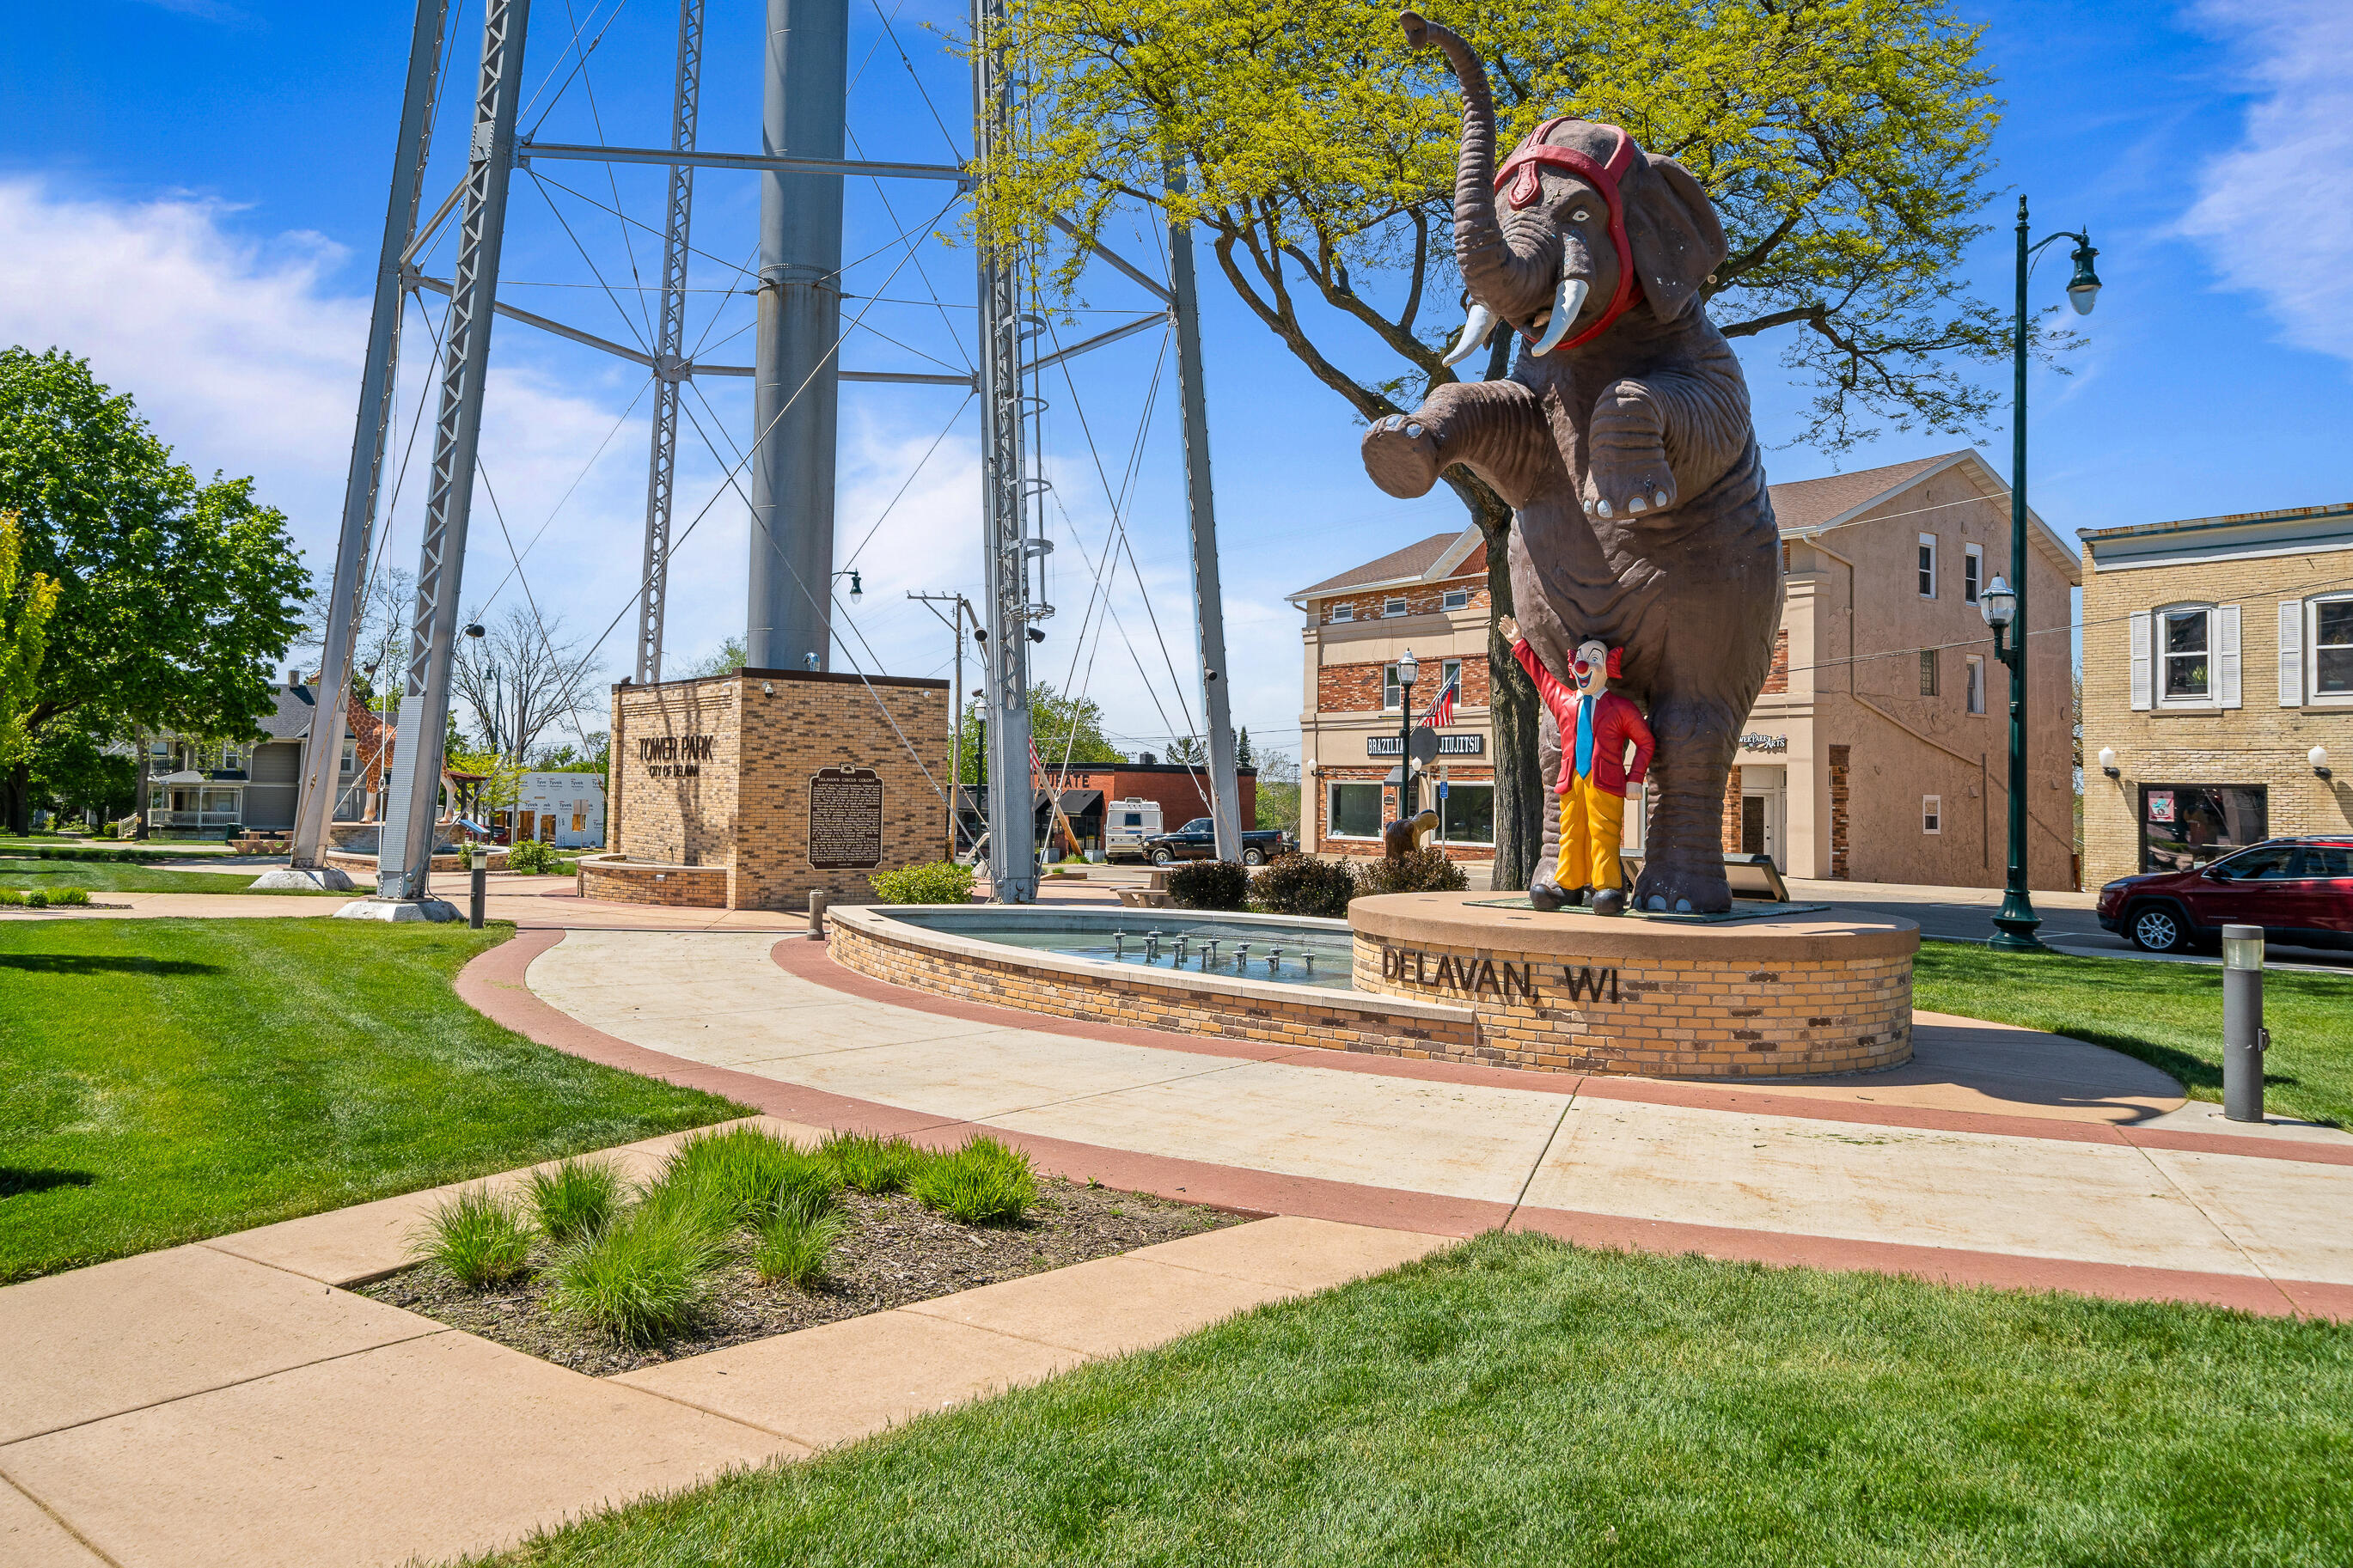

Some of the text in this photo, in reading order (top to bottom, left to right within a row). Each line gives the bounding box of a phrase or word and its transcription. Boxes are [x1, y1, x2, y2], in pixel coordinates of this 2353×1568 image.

[639, 735, 714, 761] TOWER PARK
[1368, 736, 1480, 754] BRAZILIA JIUJITSU
[649, 765, 700, 778] CITY OF DELAVAN
[1382, 946, 1617, 1004] DELAVAN, WI
